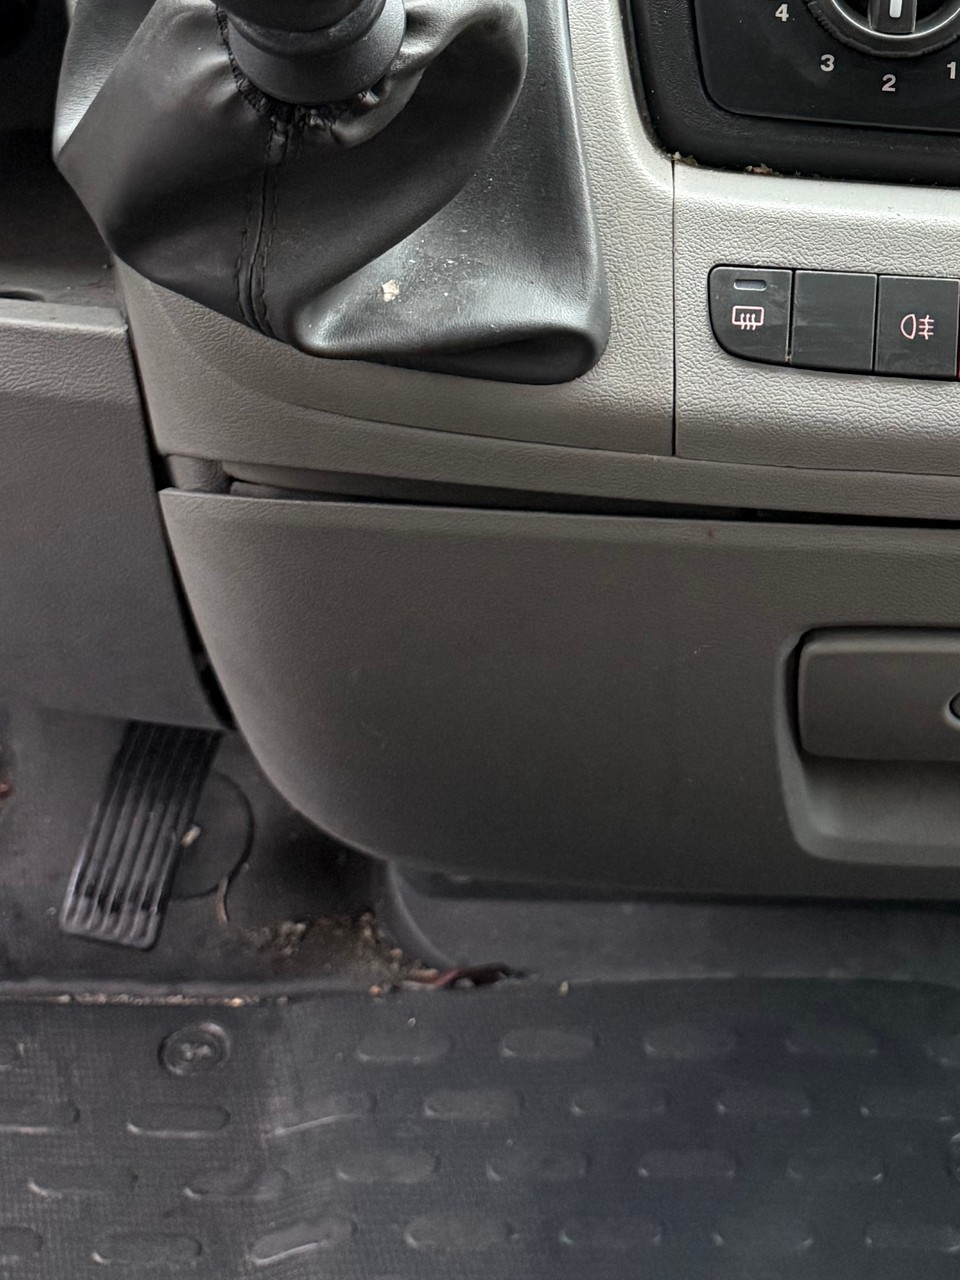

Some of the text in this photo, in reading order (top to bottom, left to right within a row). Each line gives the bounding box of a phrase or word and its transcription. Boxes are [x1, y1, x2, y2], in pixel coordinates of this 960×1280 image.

[774, 3, 789, 22] 4
[820, 54, 835, 72] 3
[946, 61, 956, 80] 1
[881, 74, 896, 92] 2
